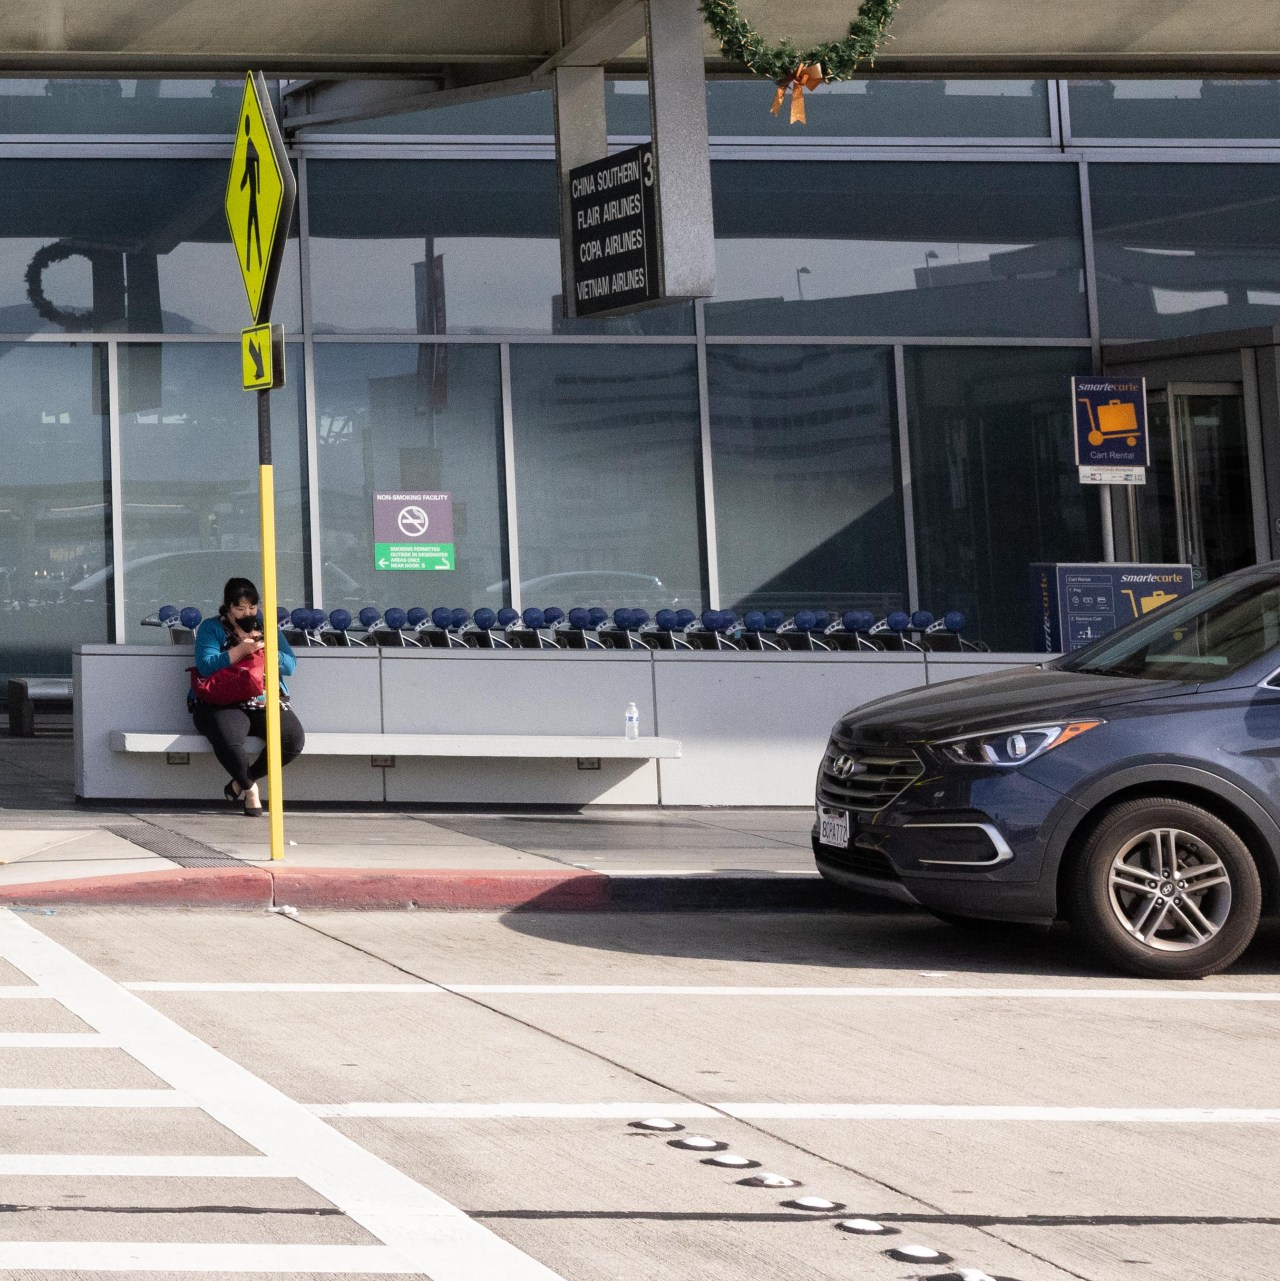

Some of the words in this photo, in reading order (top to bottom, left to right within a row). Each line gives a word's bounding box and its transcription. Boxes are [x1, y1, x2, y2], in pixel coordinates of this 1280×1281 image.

[572, 175, 595, 198] CHINA
[597, 160, 639, 191] SOUTHERN
[644, 152, 653, 187] 3
[578, 206, 600, 230] FLAIR
[603, 194, 640, 222] AIRLINES
[580, 239, 602, 262] COPA
[605, 229, 642, 256] AIRLINES
[577, 275, 610, 301] VIETNAM
[611, 268, 644, 293] AIRLINES
[1090, 451, 1107, 459] Cart
[1110, 451, 1134, 459] Rental
[1120, 574, 1182, 583] smartecarte
